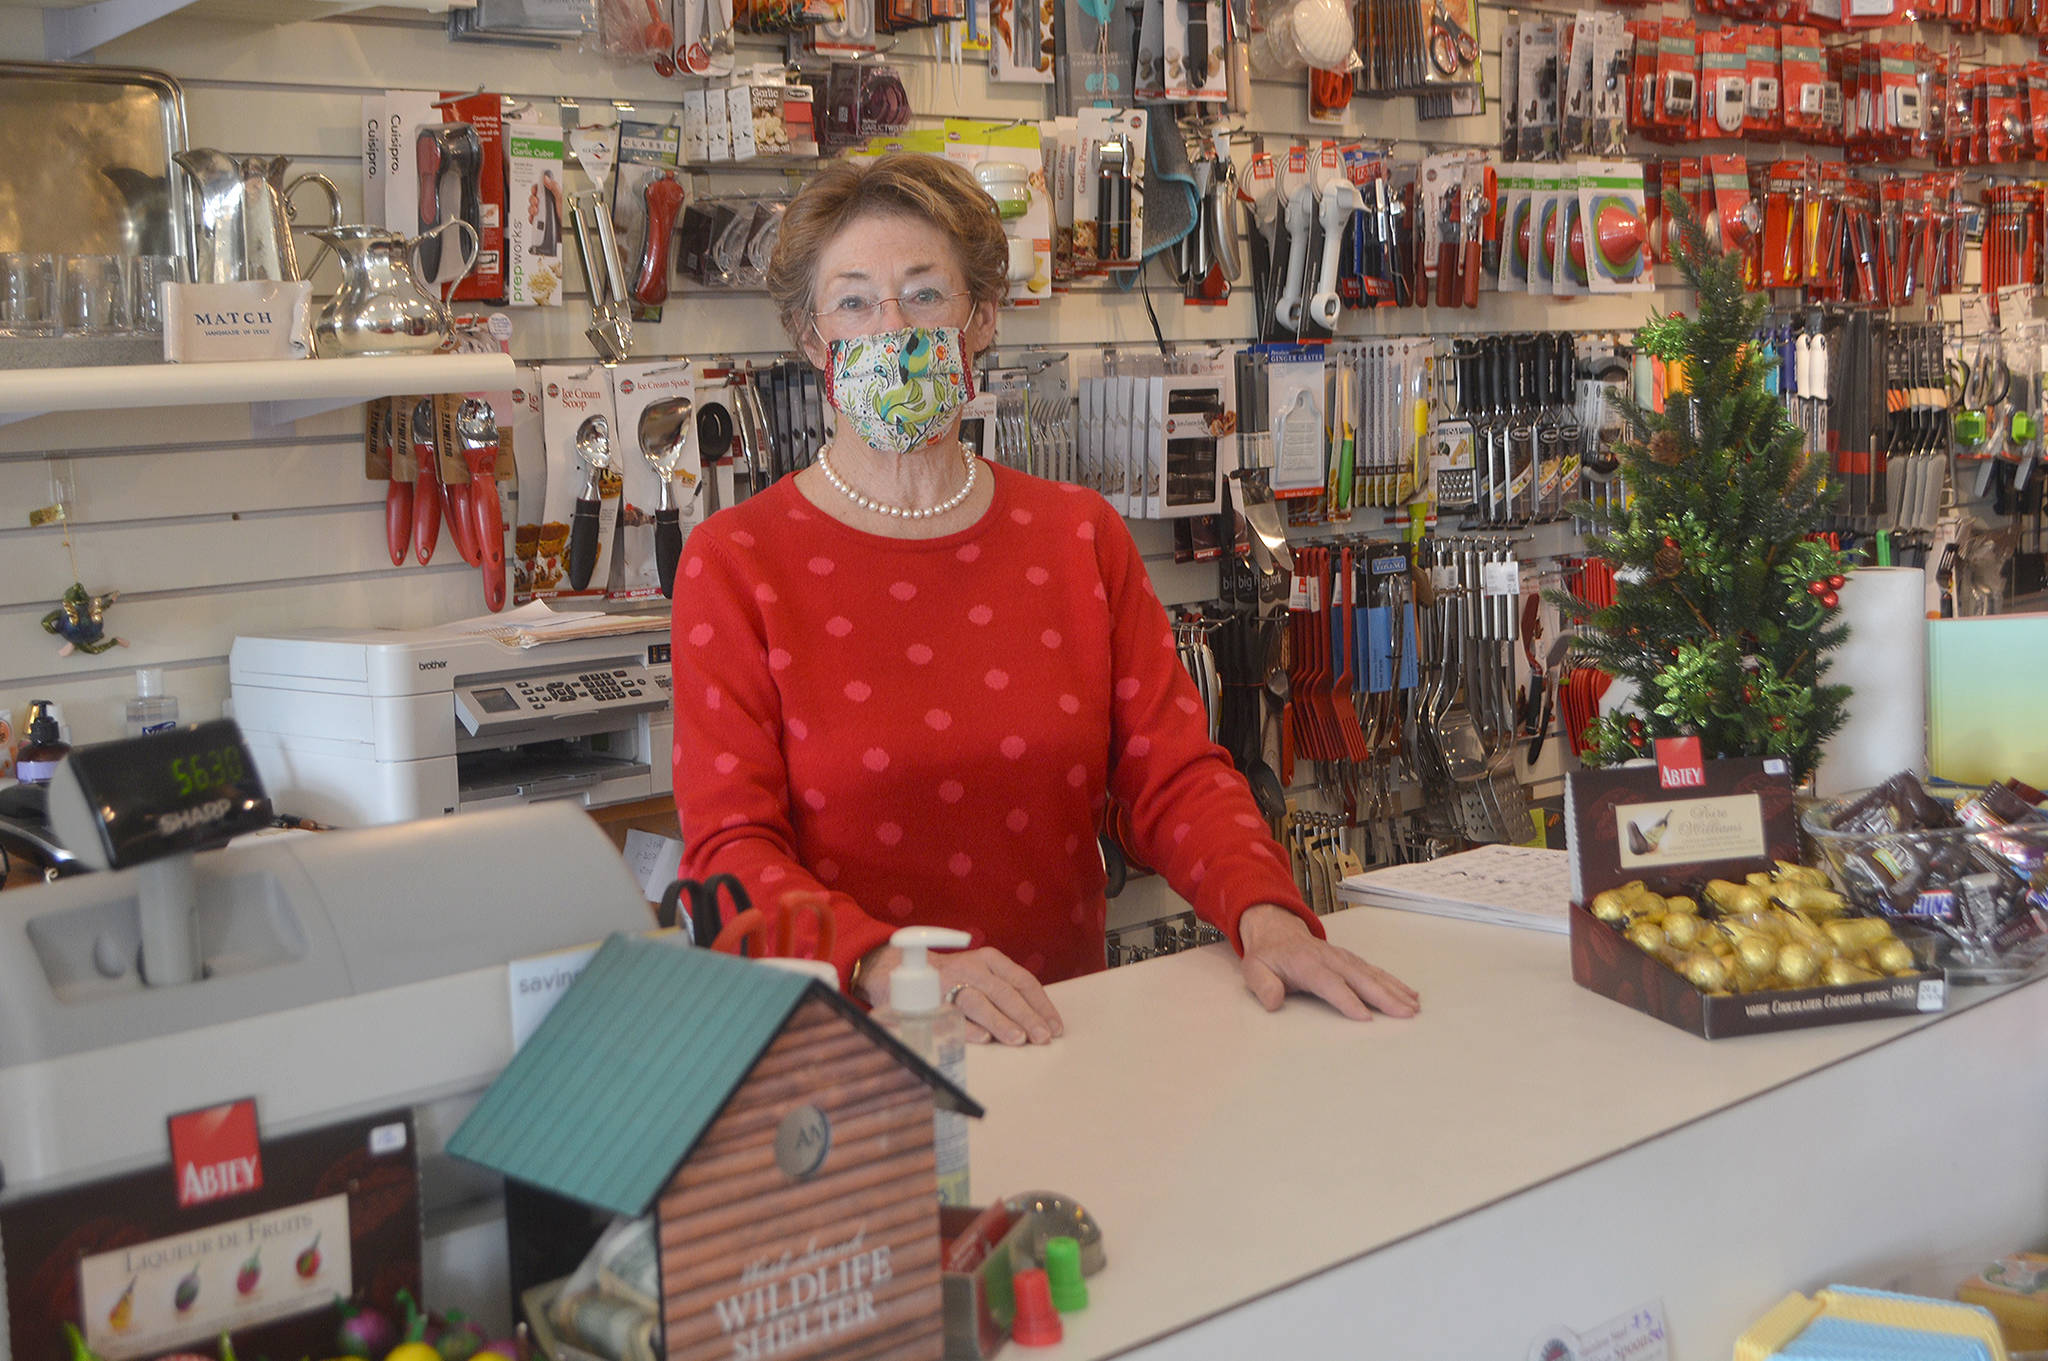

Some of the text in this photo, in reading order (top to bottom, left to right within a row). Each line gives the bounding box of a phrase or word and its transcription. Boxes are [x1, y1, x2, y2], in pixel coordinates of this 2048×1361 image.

[752, 87, 779, 99] Garlic
[623, 138, 676, 151] CLASSIC
[513, 218, 523, 302] prepworks
[194, 312, 273, 326] MATCH
[204, 329, 240, 337] HANDMADE
[1270, 353, 1323, 362] GINGER GRATER
[637, 382, 647, 390] Ice
[647, 381, 670, 390] Cream
[562, 388, 601, 400] Ice Cream
[562, 399, 587, 411] Scoop
[1375, 559, 1404, 571] VIKING
[1238, 575, 1252, 591] big
[418, 659, 448, 672] brother
[1661, 765, 1701, 787] ABTEY
[158, 798, 233, 837] SHARP
[1892, 984, 1915, 999] 1946
[183, 1154, 258, 1202] ABTEY
[716, 1245, 894, 1333] WILDLIFE
[732, 1291, 878, 1361] SHELTER
